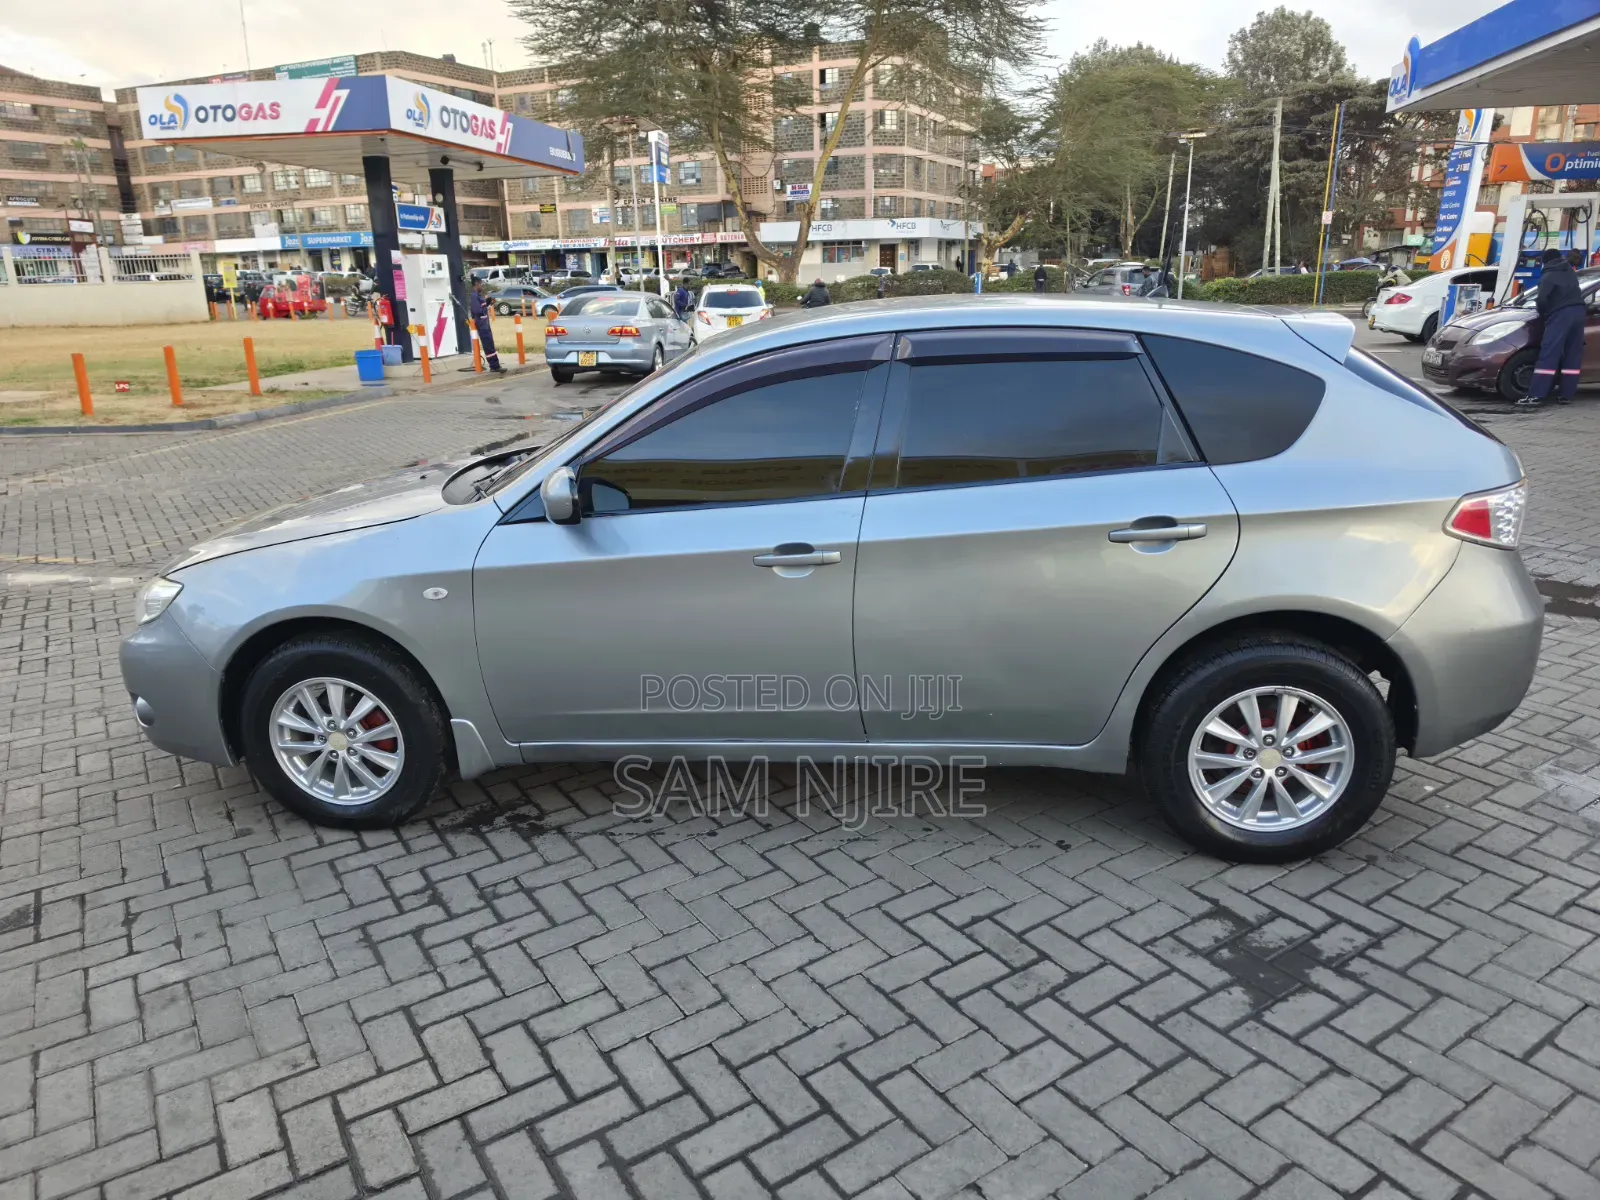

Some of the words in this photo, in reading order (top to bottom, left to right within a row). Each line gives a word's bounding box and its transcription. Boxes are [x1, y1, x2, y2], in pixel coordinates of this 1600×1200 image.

[1389, 74, 1407, 97] OLA
[194, 101, 282, 124] OTOGAS
[406, 110, 424, 124] OLA
[149, 113, 179, 126] OLA
[439, 105, 496, 141] OTOGAS
[1498, 164, 1508, 173] 7
[811, 223, 833, 232] HFCB
[896, 221, 917, 231] HFCB
[307, 236, 352, 245] SUPERMARKET
[656, 236, 701, 245] UTCHERY
